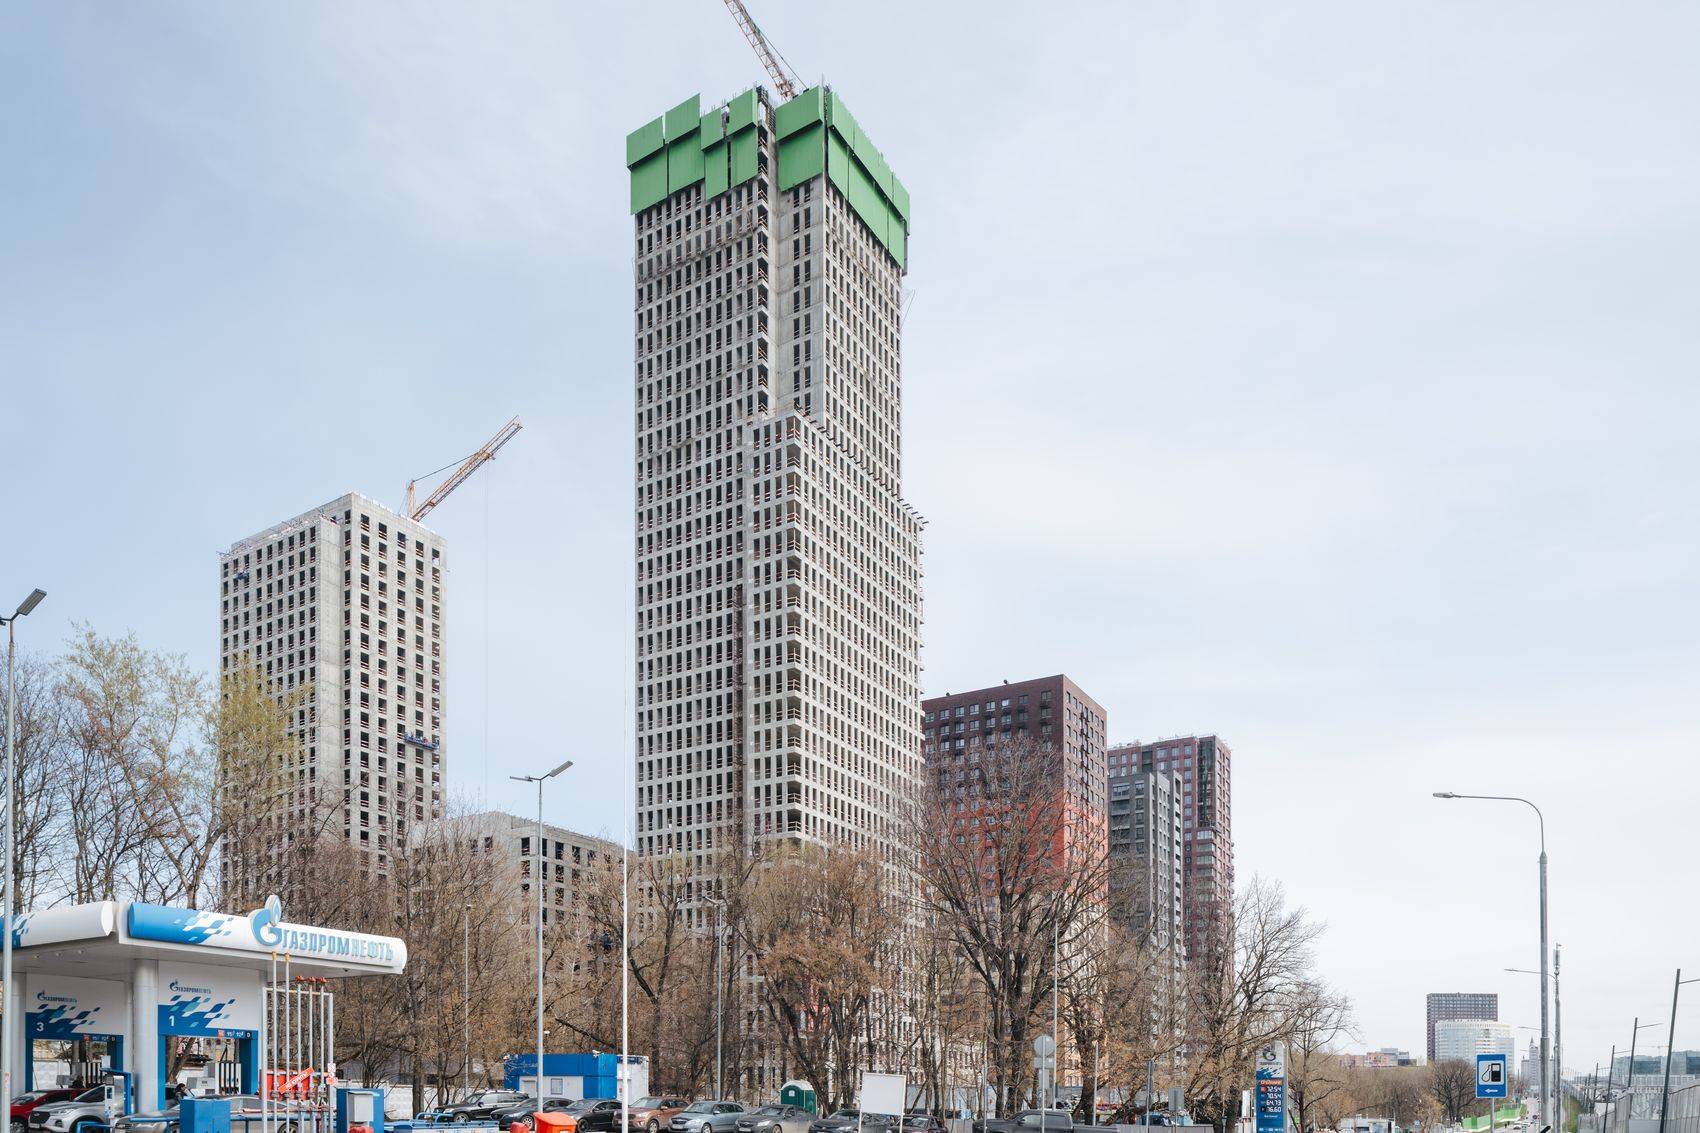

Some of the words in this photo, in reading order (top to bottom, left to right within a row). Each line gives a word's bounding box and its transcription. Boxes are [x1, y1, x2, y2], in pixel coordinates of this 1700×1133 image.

[282, 929, 394, 960] ГАЗПРОМНЕФТЬ
[36, 1022, 44, 1032] 3
[169, 1015, 175, 1027] 1
